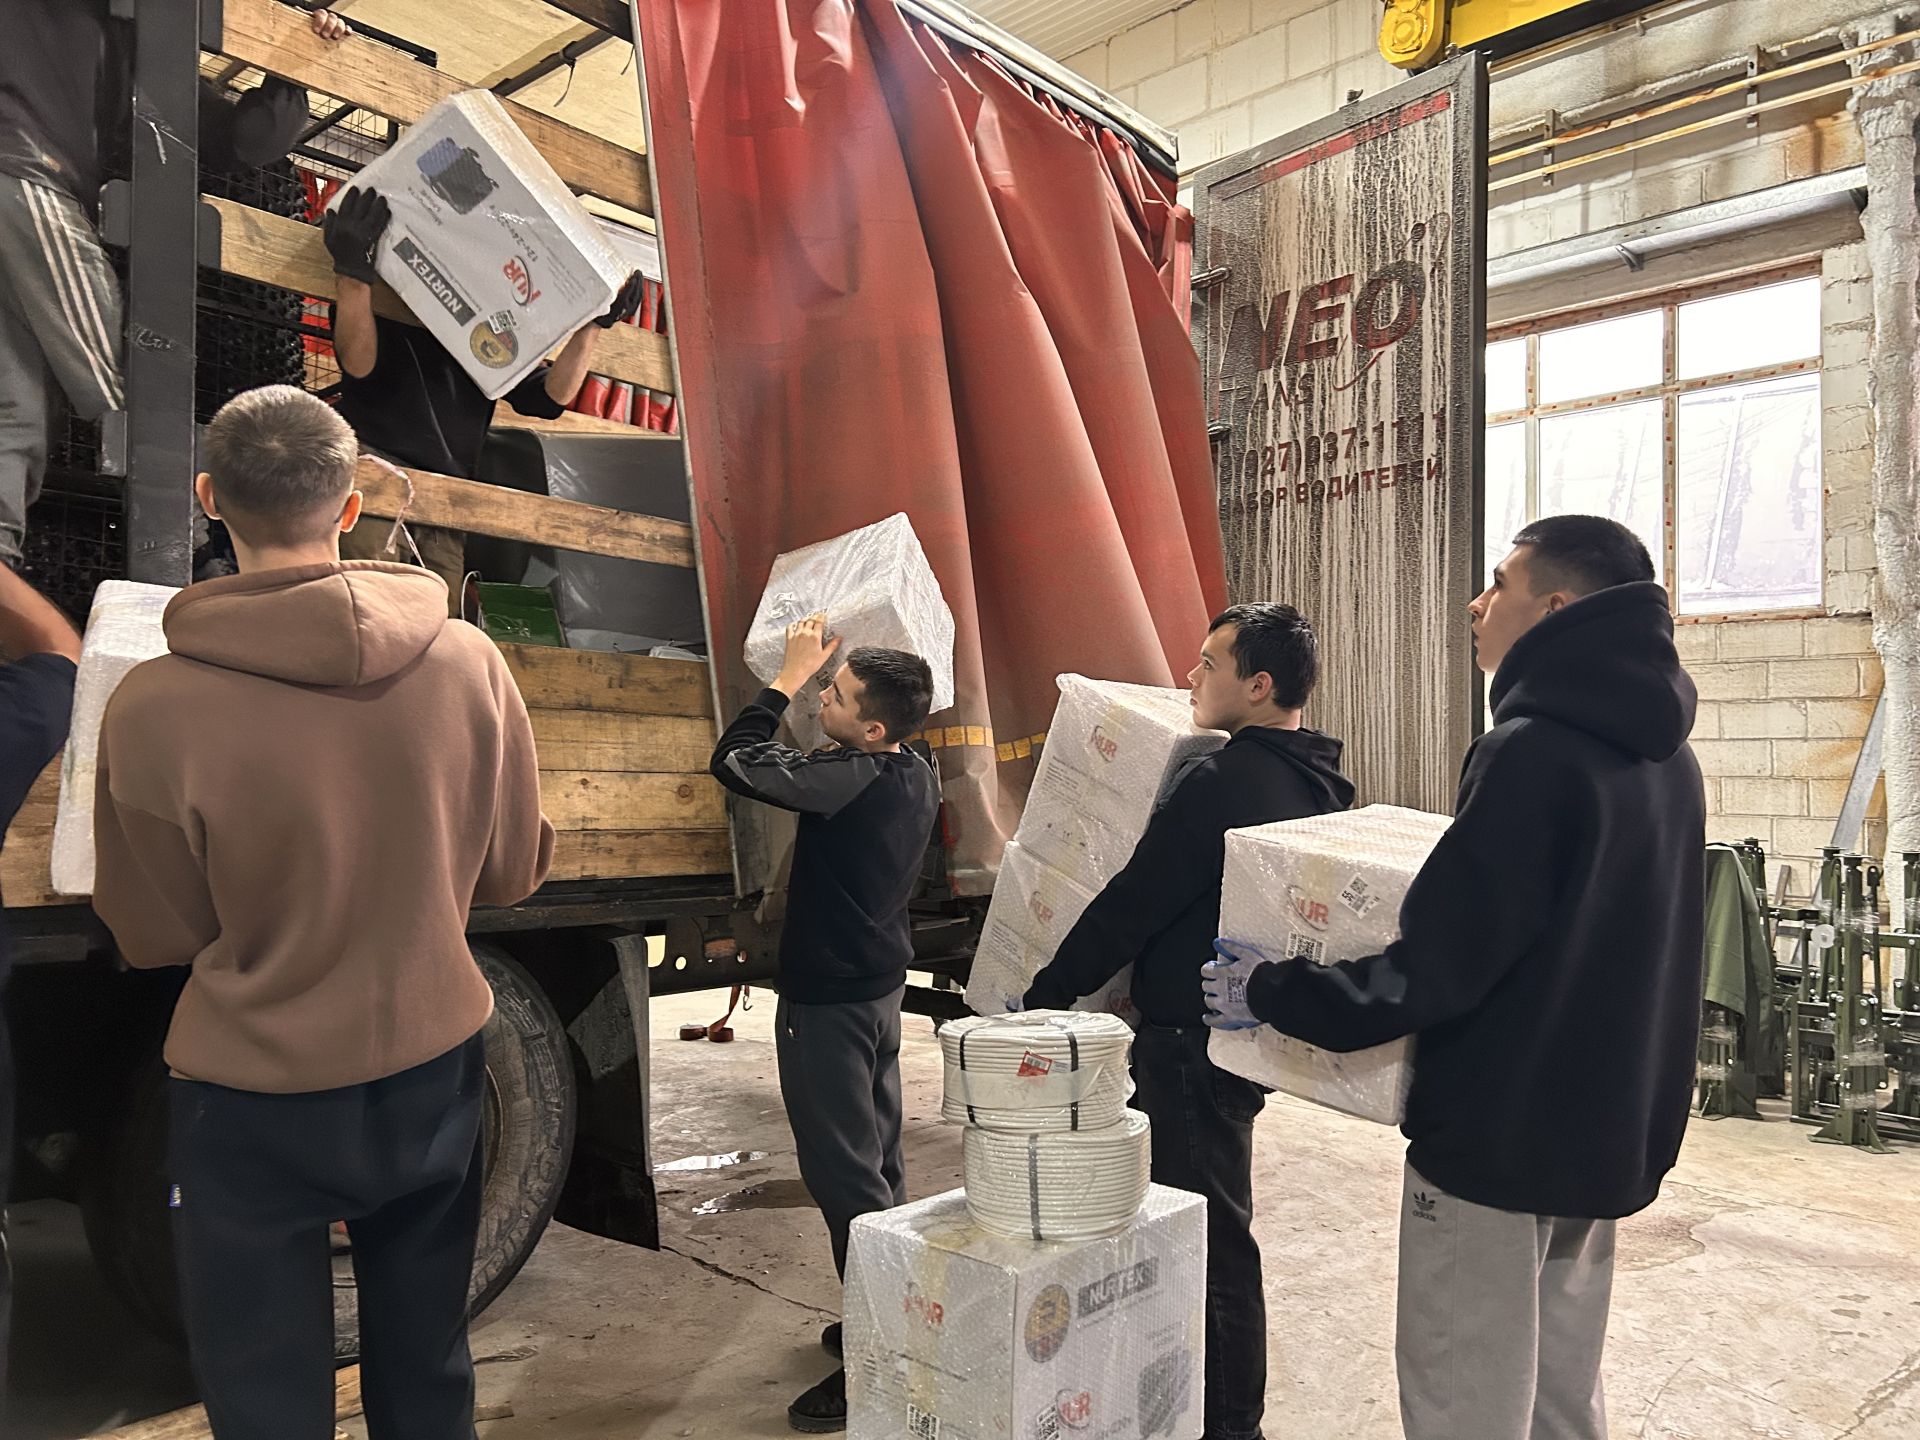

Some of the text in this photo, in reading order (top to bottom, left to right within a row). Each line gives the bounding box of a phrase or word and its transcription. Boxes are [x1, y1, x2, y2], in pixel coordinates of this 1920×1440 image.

[408, 253, 463, 313] NURTEX
[1220, 261, 1427, 376] NEO
[1293, 896, 1329, 925] UR
